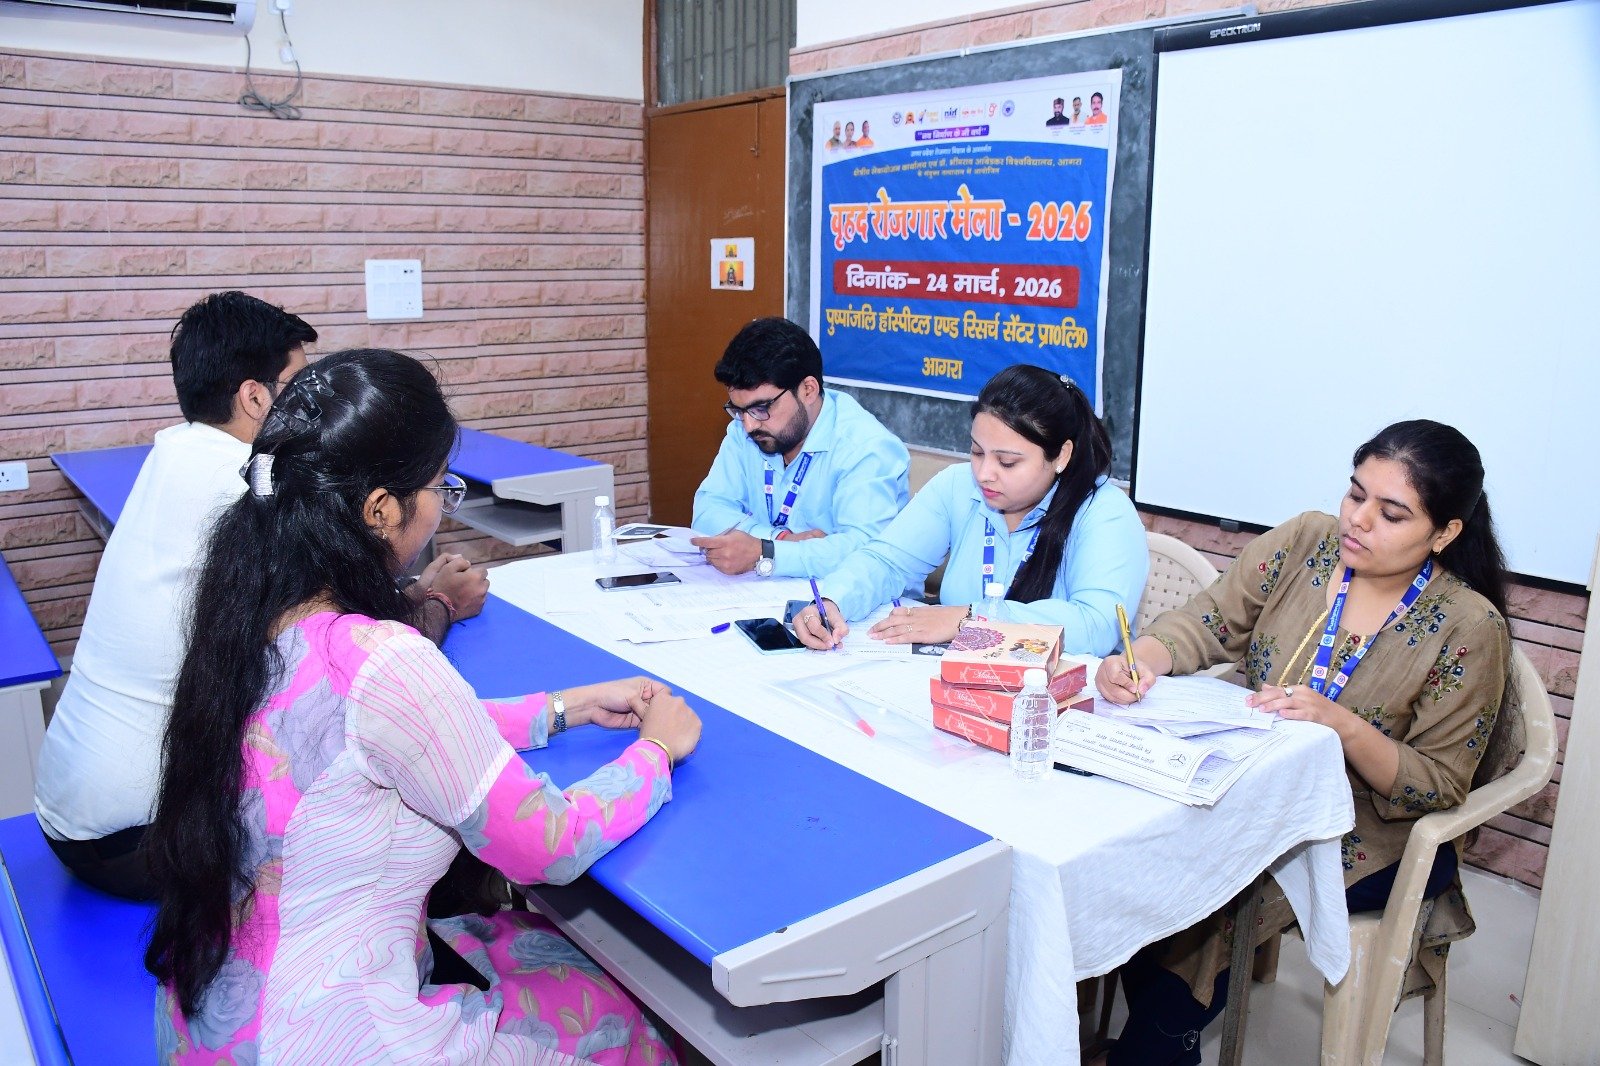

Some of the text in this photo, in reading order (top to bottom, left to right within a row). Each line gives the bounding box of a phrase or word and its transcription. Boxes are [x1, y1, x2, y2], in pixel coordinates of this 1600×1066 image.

[1209, 23, 1261, 39] SPECKTRON
[869, 187, 949, 241] रोजगार
[949, 183, 1006, 241] मेला
[1026, 201, 1093, 242] 2026
[926, 273, 947, 292] 24
[953, 268, 1006, 297] मार्च,
[1014, 277, 1062, 299] 2026
[933, 316, 960, 338] एण्ड
[963, 310, 1000, 341] रिसर्च
[1002, 314, 1035, 344] सेंटर
[921, 356, 963, 379] आगरा
